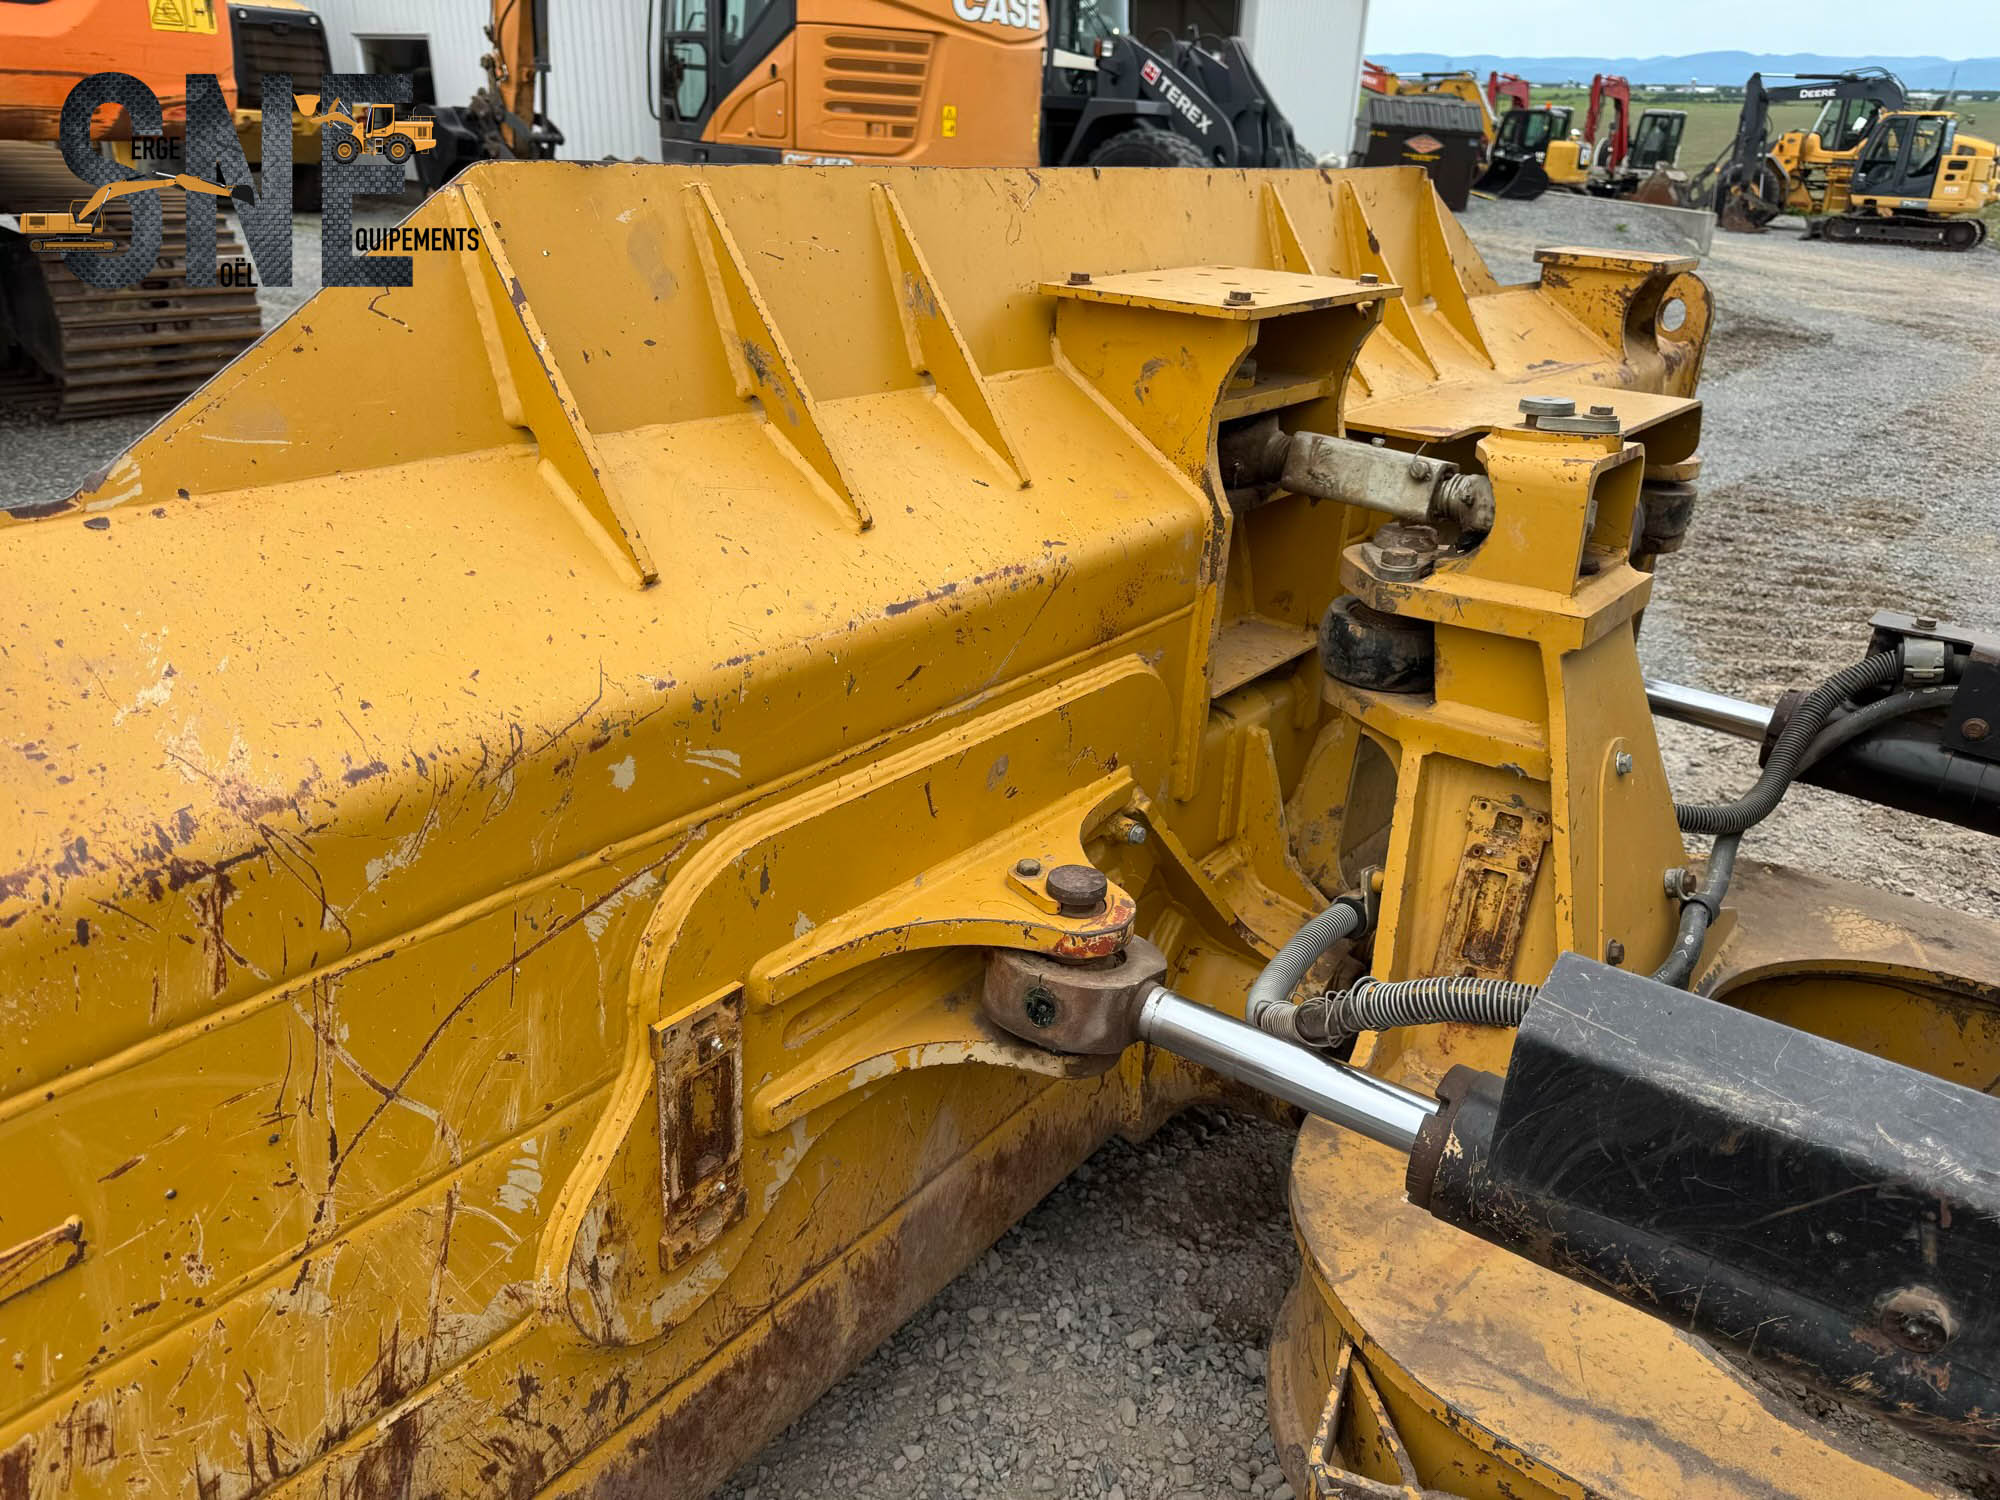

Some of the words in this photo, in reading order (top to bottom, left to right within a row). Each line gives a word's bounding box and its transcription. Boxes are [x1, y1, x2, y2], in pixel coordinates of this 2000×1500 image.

[952, 0, 1041, 31] CASE
[1159, 75, 1213, 135] TEREX
[1800, 89, 1837, 99] DEERE
